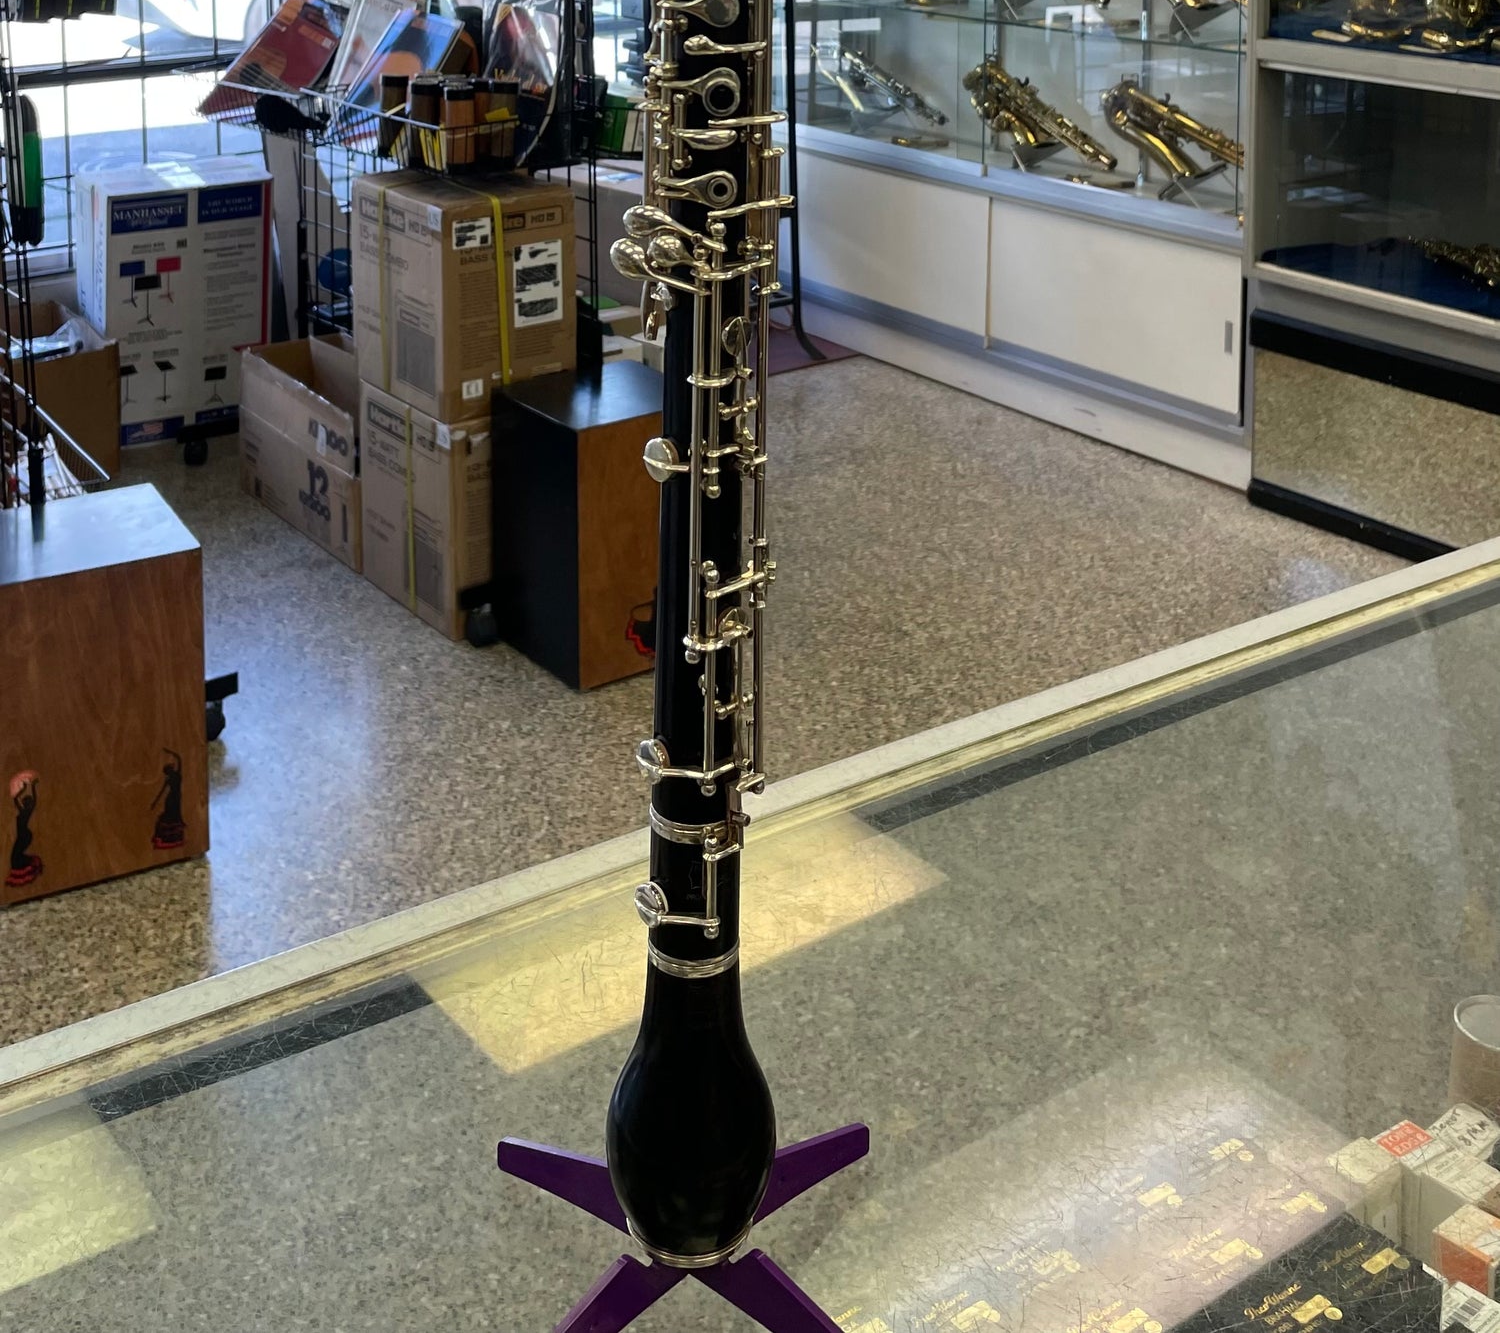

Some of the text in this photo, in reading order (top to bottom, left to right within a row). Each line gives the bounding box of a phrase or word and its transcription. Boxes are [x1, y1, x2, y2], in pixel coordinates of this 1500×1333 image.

[113, 204, 186, 222] MANHASSET
[1382, 1125, 1414, 1147] TONE
[1392, 1132, 1429, 1155] EDGE
